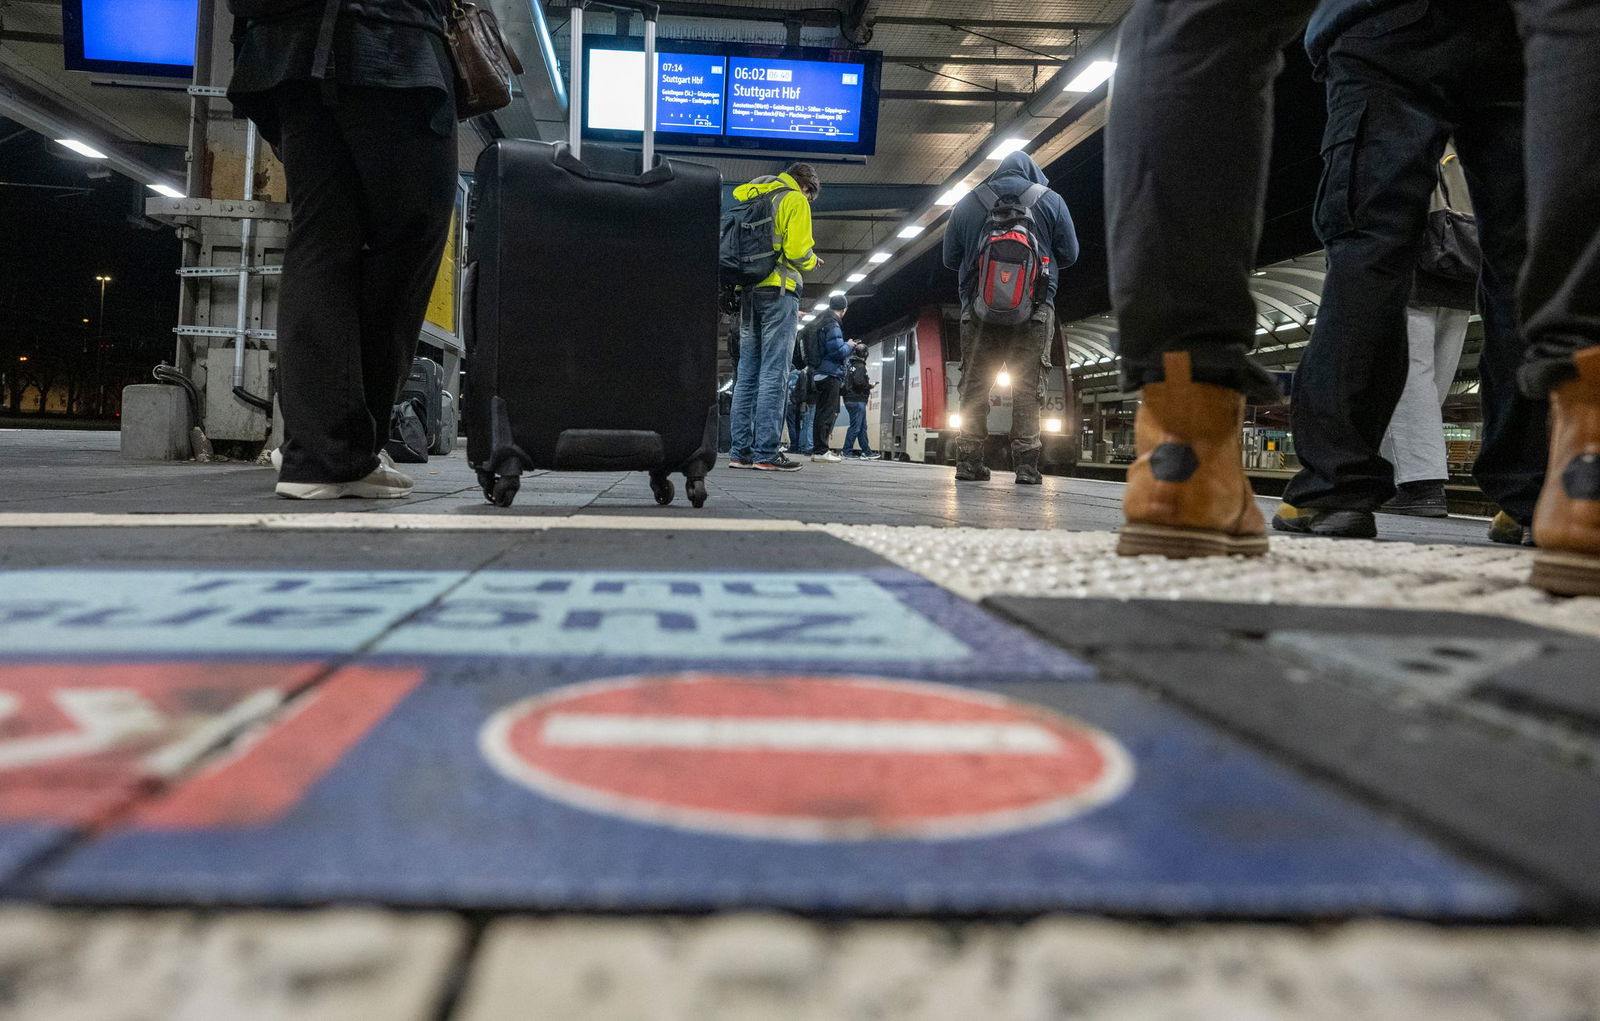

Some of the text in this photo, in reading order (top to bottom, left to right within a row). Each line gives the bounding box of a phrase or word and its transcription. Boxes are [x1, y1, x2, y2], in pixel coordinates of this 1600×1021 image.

[662, 63, 683, 72] 07:14
[734, 67, 766, 81] 06:02
[662, 74, 704, 85] Stuttgart Hbf
[733, 84, 801, 100] Stuttgart Hbf
[178, 577, 836, 598] nur zu
